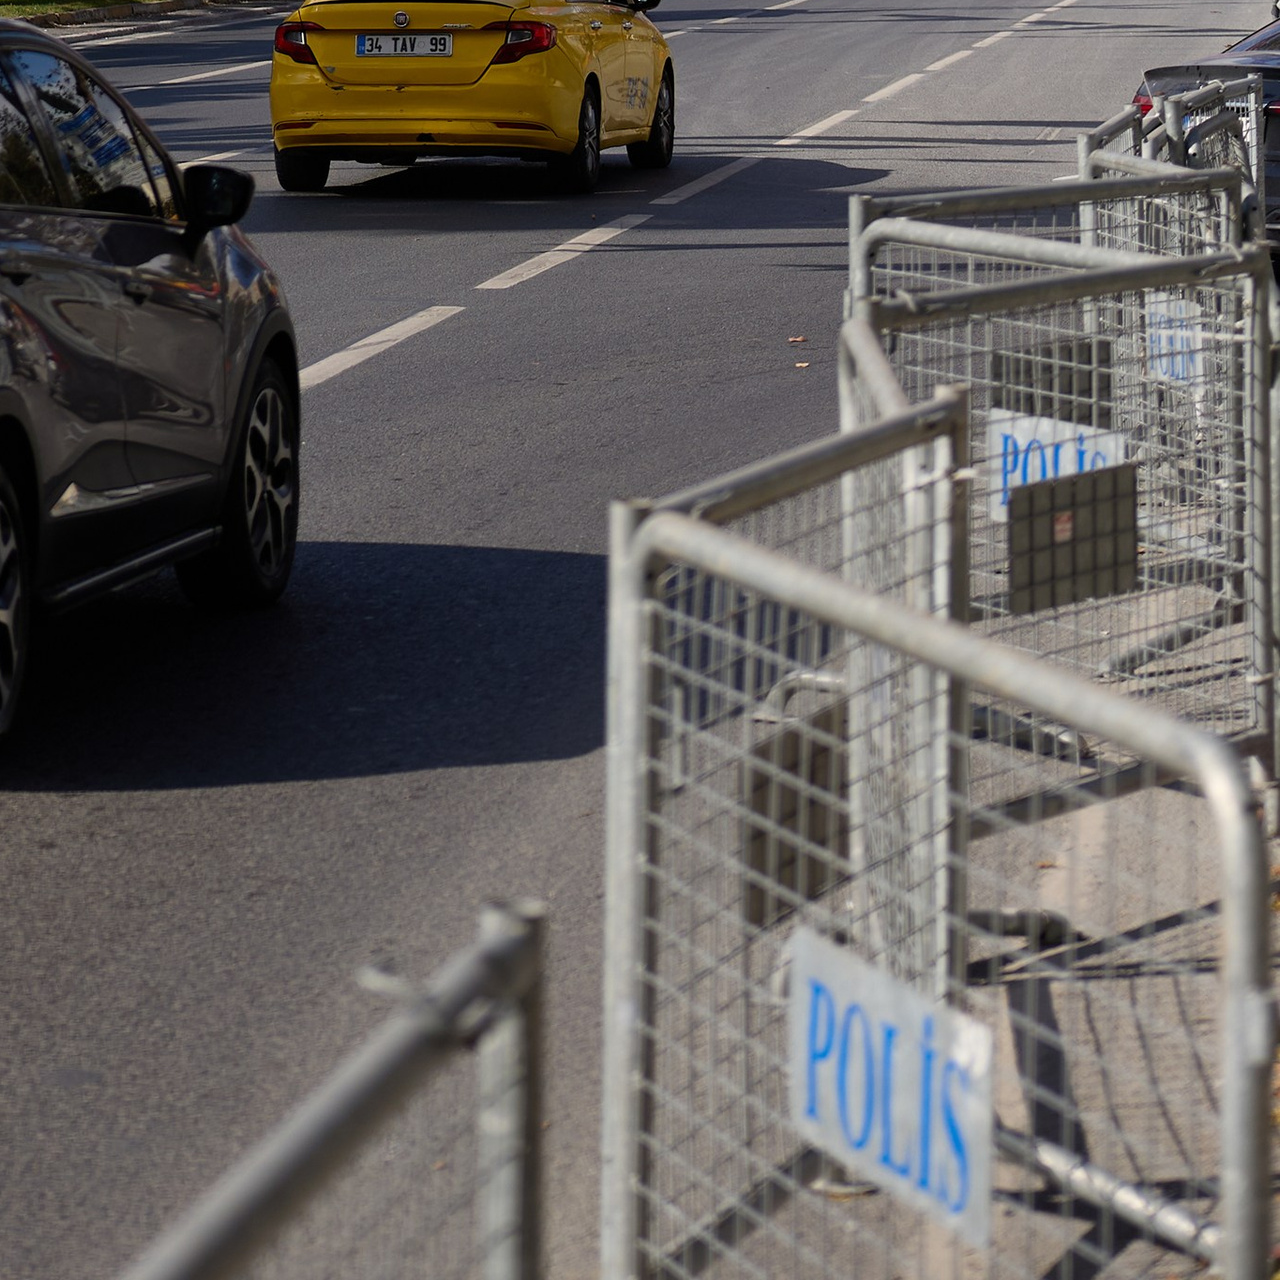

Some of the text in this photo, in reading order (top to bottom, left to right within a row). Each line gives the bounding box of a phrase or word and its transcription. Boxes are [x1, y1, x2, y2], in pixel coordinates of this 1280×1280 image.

[366, 37, 382, 53] 34
[391, 37, 417, 53] TAV
[429, 37, 447, 53] 99
[806, 977, 969, 1214] POLİS
